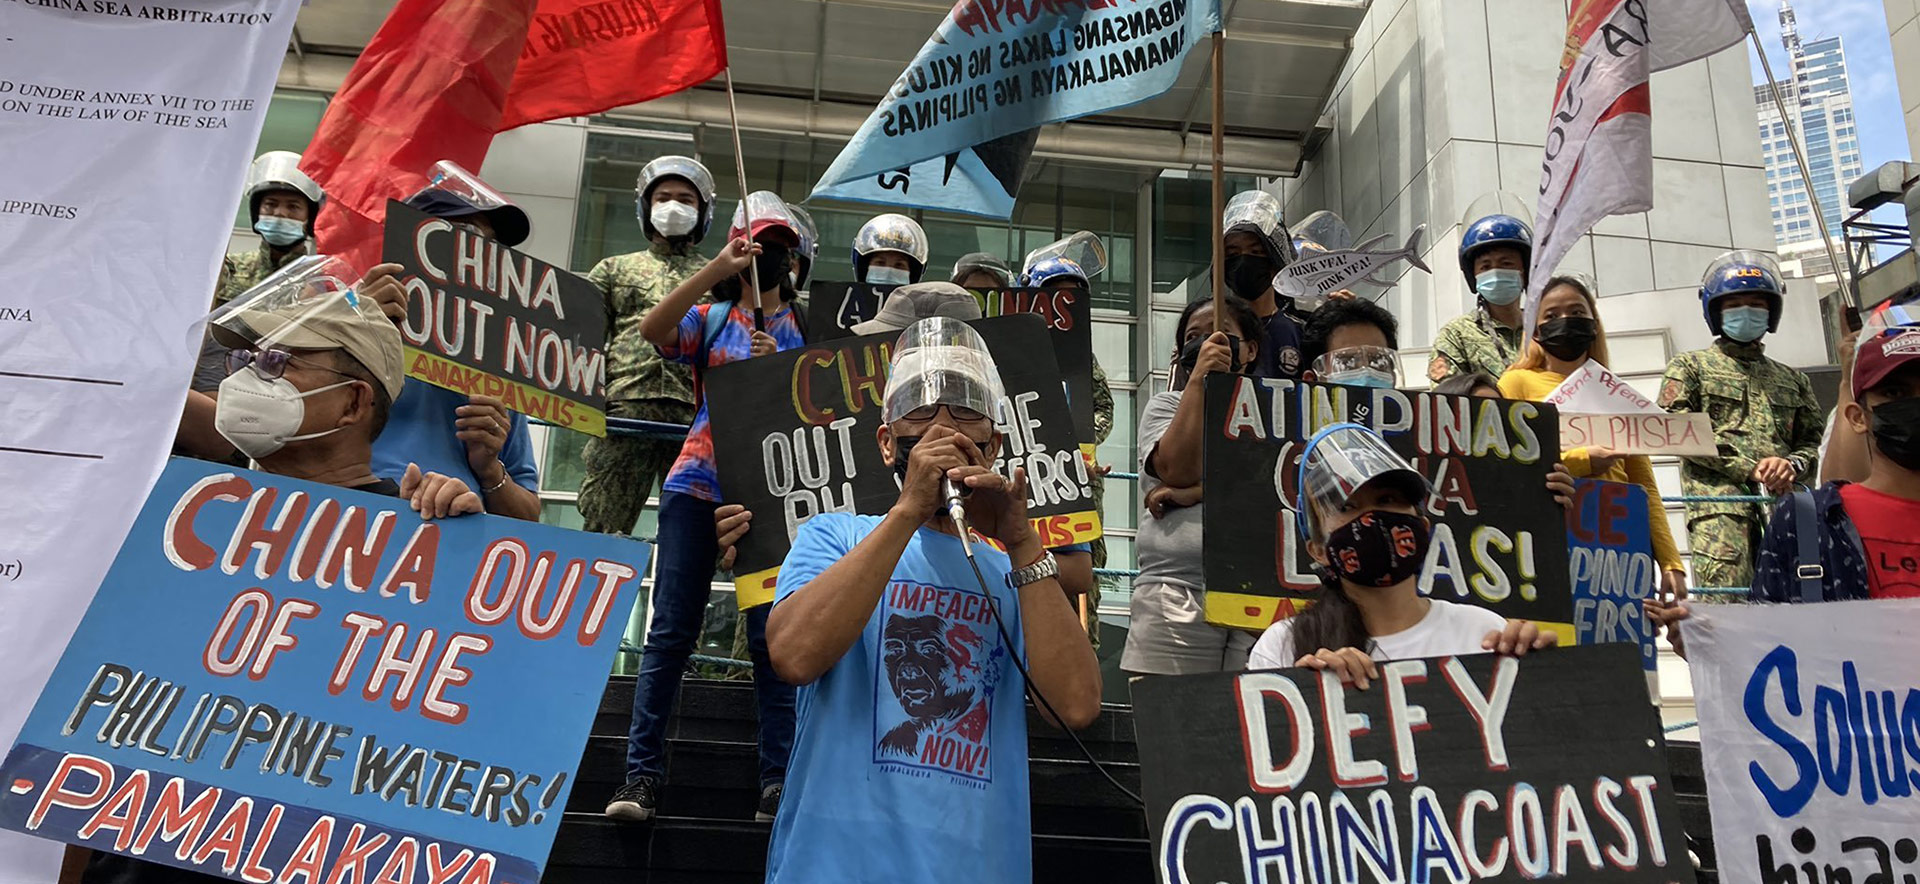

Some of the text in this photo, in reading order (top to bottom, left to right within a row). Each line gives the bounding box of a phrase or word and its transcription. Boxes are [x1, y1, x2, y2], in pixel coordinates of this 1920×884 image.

[94, 1, 132, 17] SEA
[138, 6, 273, 25] ARBITRATION
[2, 101, 228, 129] ON THE LAW OF THE SEA
[19, 84, 86, 101] UNDER
[90, 91, 155, 105] ANNEX
[160, 94, 187, 108] VII
[192, 98, 216, 111] TO
[221, 99, 254, 111] THE
[413, 217, 565, 320] CHINA
[1288, 254, 1348, 278] JUNK VFA!
[1317, 256, 1372, 294] JUNK VFA!
[401, 275, 495, 364] OUT
[762, 417, 857, 497] OUT
[994, 391, 1047, 456] HE
[1224, 376, 1541, 465] ATIN NG PINAS
[163, 472, 636, 646] CHINA OUT
[1275, 508, 1538, 601] LAS!
[889, 583, 994, 625] IMPEACH
[202, 587, 494, 724] OF THE
[60, 662, 568, 828] PHILIPPINE WATERS!
[920, 734, 989, 776] NOW!
[1234, 656, 1520, 793] DEFY
